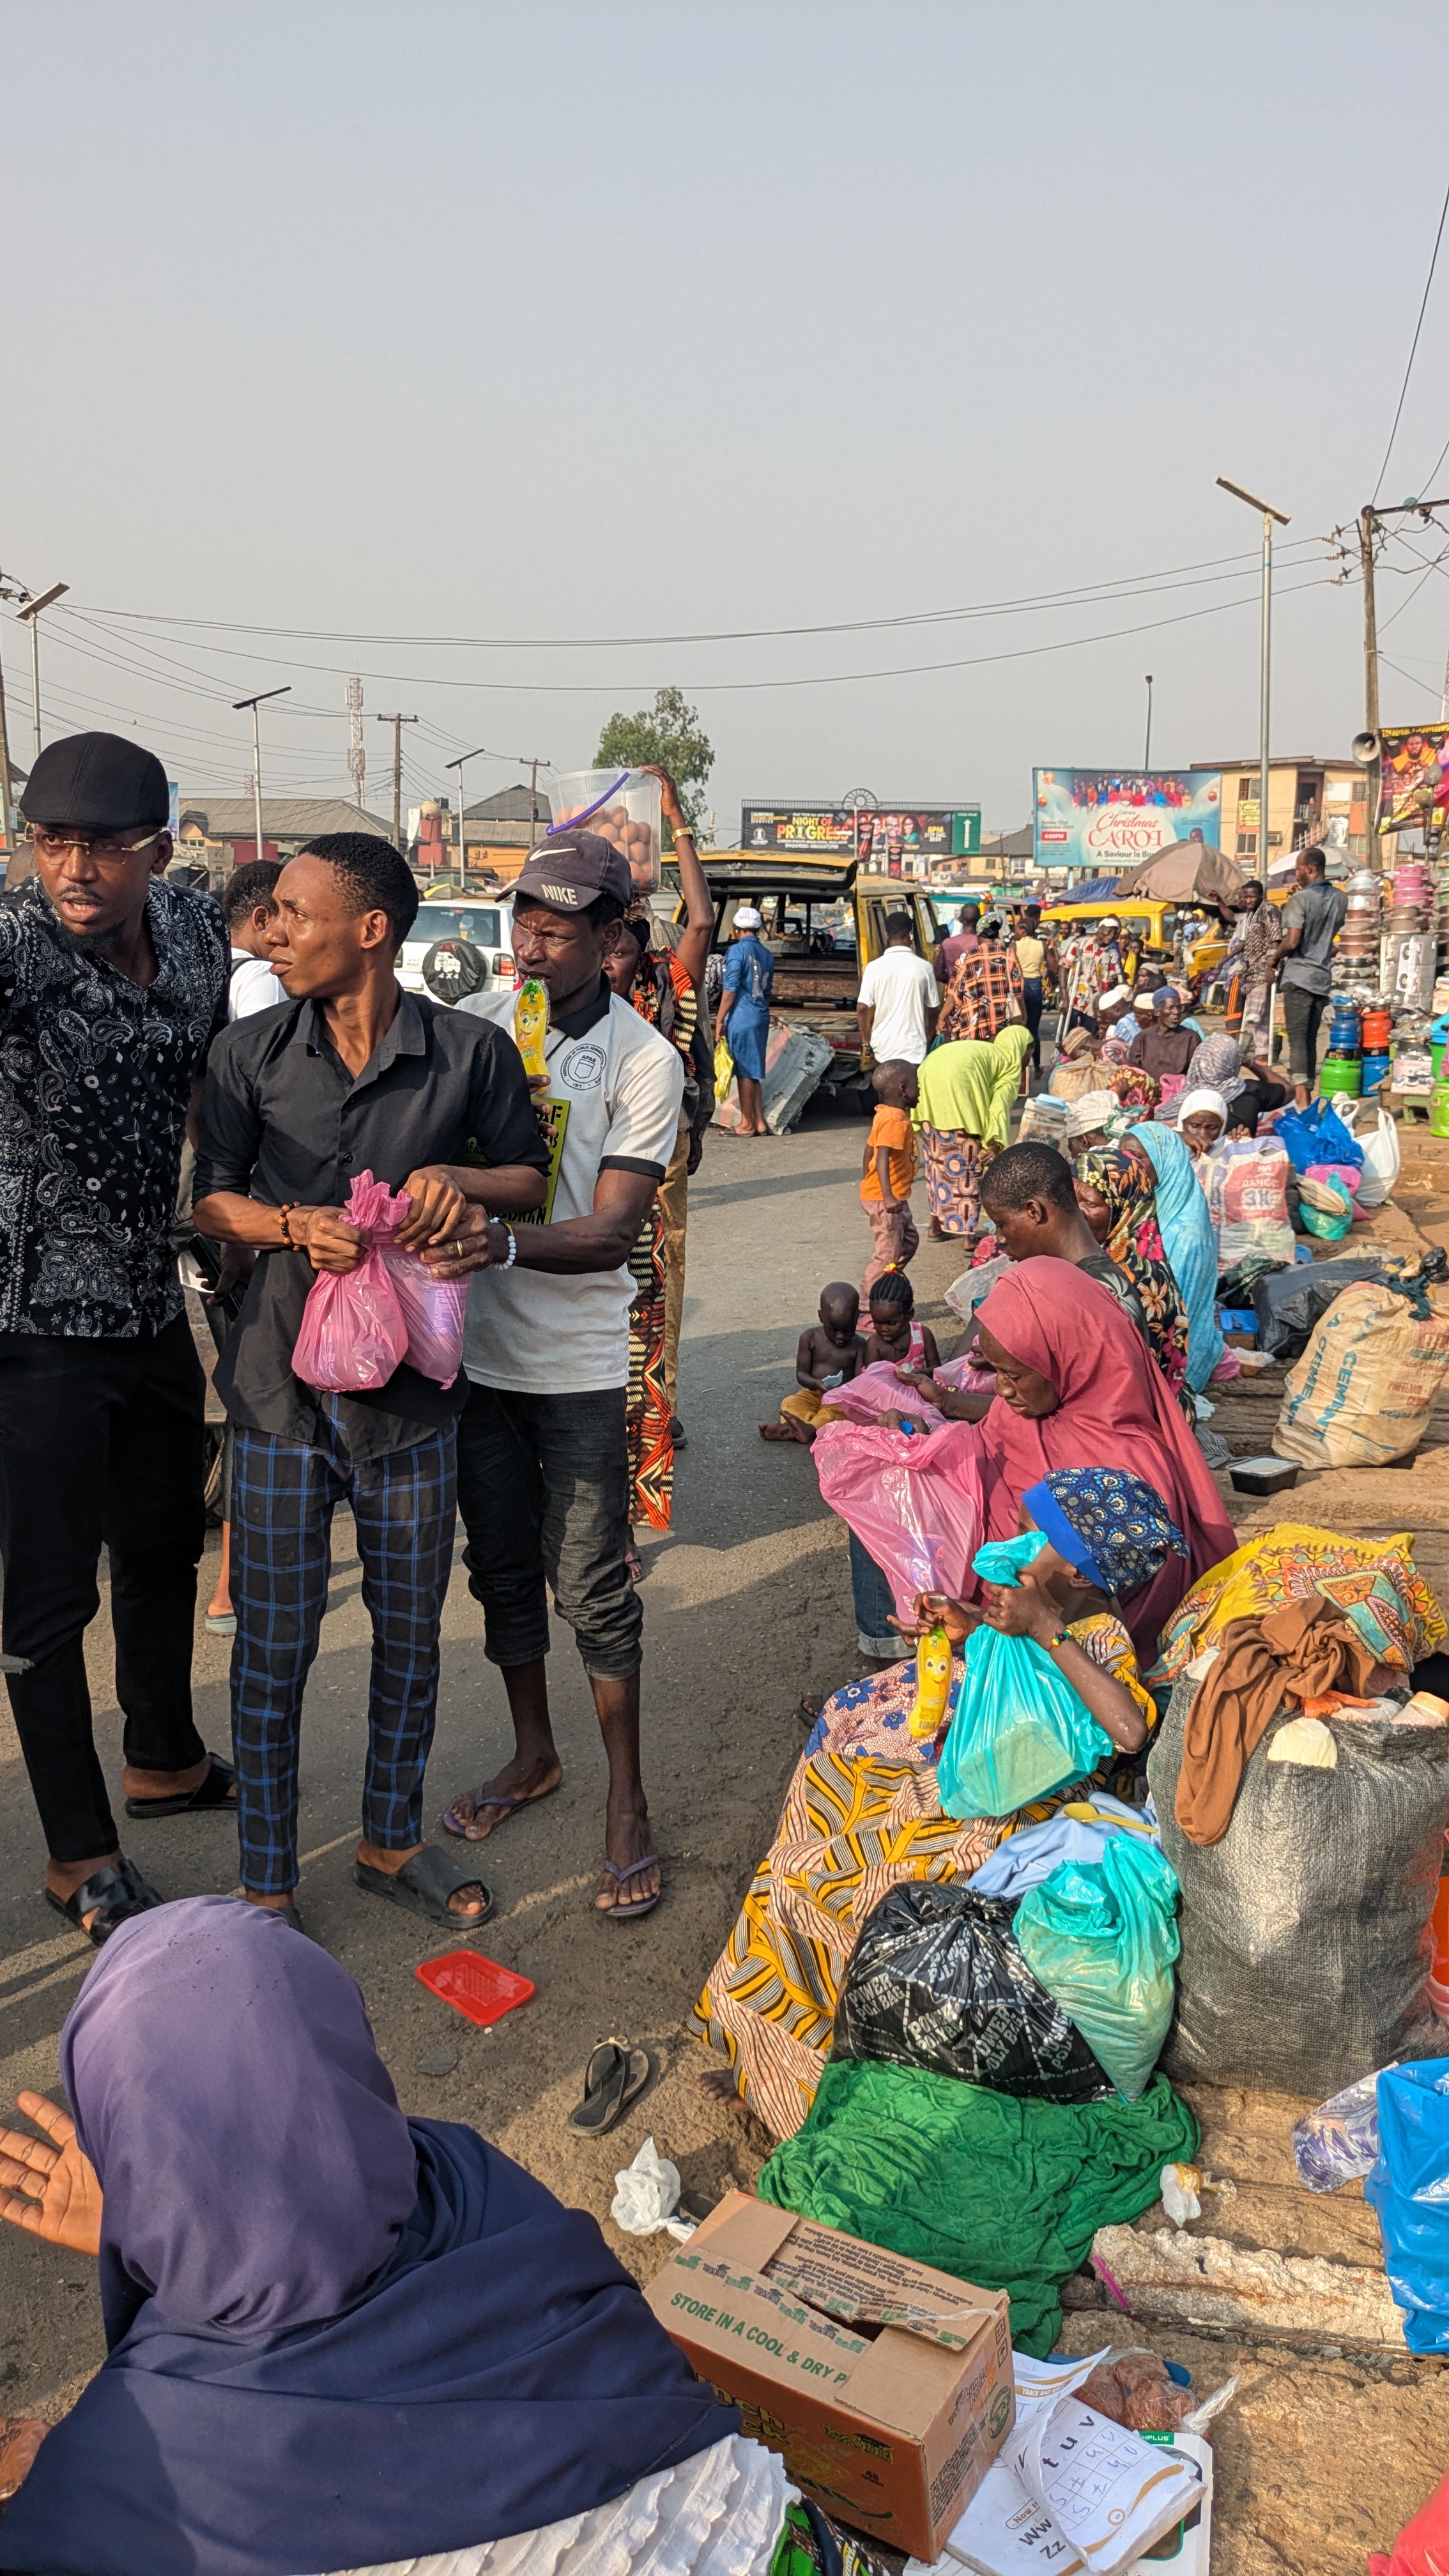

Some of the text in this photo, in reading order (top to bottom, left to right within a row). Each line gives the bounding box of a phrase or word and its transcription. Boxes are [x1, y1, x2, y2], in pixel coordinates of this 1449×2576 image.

[792, 817, 819, 825] NIGHT
[1096, 812, 1159, 832] Christmas
[1089, 829, 1163, 851] CAROL
[541, 884, 578, 905] NIKE
[1287, 1335, 1327, 1427] CEMENT
[1313, 1351, 1358, 1443] CEMENT
[847, 1972, 893, 2008] POWER
[856, 1984, 905, 2021] POLY BAG
[976, 2005, 1011, 2057] OWER
[985, 2039, 1010, 2071] OLY
[1003, 2012, 1023, 2045] BAG
[813, 2241, 835, 2253] carbonate
[814, 2261, 826, 2269] their
[839, 2253, 857, 2262] sodium
[859, 2254, 880, 2266] Contient
[816, 2268, 827, 2276] flour
[861, 2267, 877, 2276] grasse
[863, 2262, 877, 2270] acide
[911, 2268, 923, 2277] Sans
[827, 2273, 844, 2283] (wheat
[843, 2280, 864, 2292] Contains
[855, 2278, 876, 2289] alcoholic
[835, 2289, 858, 2301] vegetable
[671, 2292, 717, 2322] STORE
[715, 2312, 735, 2330] IN
[732, 2321, 745, 2336] A
[746, 2326, 786, 2357] COOL
[786, 2350, 800, 2364] &
[800, 2358, 836, 2379] DRY
[1022, 2388, 1039, 2396] TRACE
[696, 2373, 785, 2430] nch
[741, 2417, 791, 2445] ck
[1041, 2455, 1059, 2468] t
[1060, 2435, 1078, 2450] u
[1013, 2508, 1032, 2524] Now
[1039, 2540, 1067, 2559] Zz
